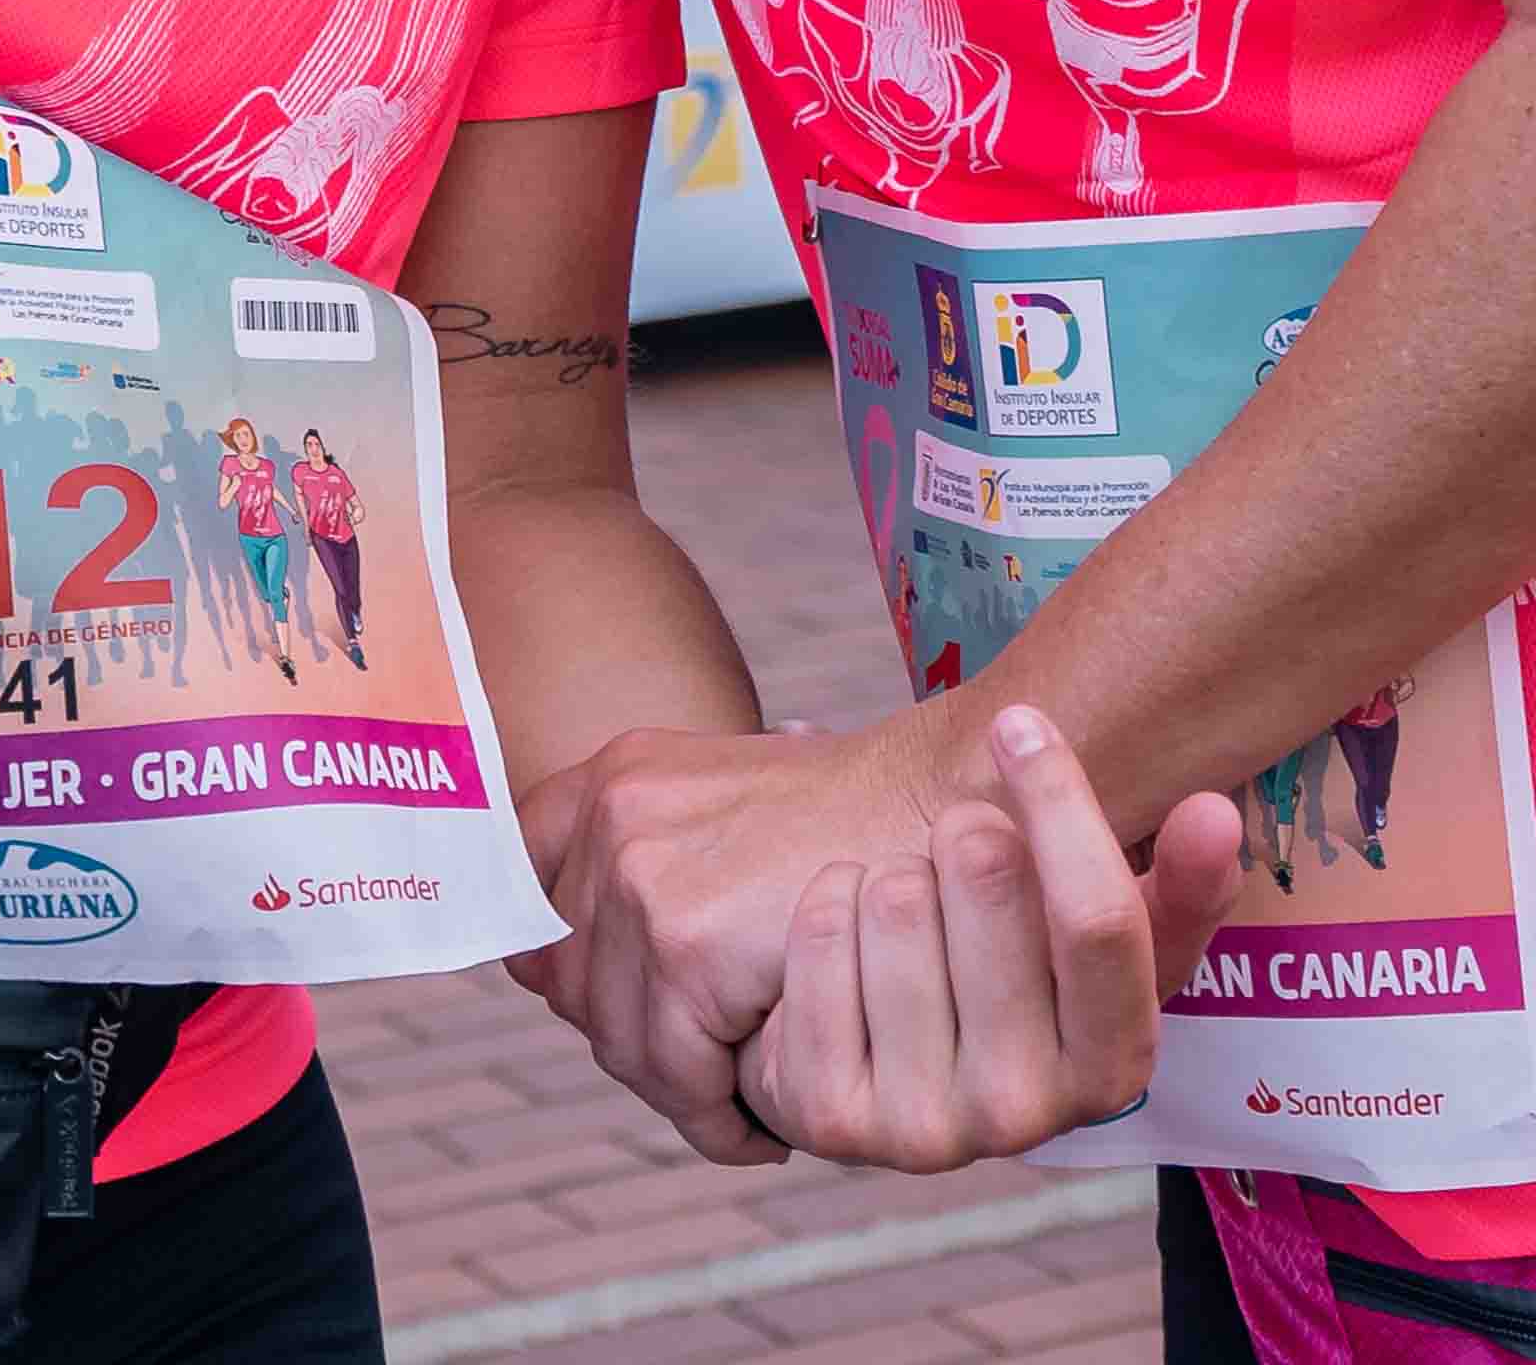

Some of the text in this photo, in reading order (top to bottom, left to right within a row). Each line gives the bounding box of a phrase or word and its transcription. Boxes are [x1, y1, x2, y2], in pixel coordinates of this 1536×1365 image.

[8, 217, 86, 239] DEPORTES
[1017, 408, 1097, 426] DEPORTES
[47, 628, 76, 646] DE
[82, 619, 174, 642] GÉNERO
[131, 742, 268, 802] GRAN
[282, 738, 458, 794] CANARIA
[34, 875, 111, 888] LECHERA
[298, 873, 442, 909] Santander
[1269, 945, 1487, 1001] CANARIA
[1286, 1086, 1446, 1118] Santander
